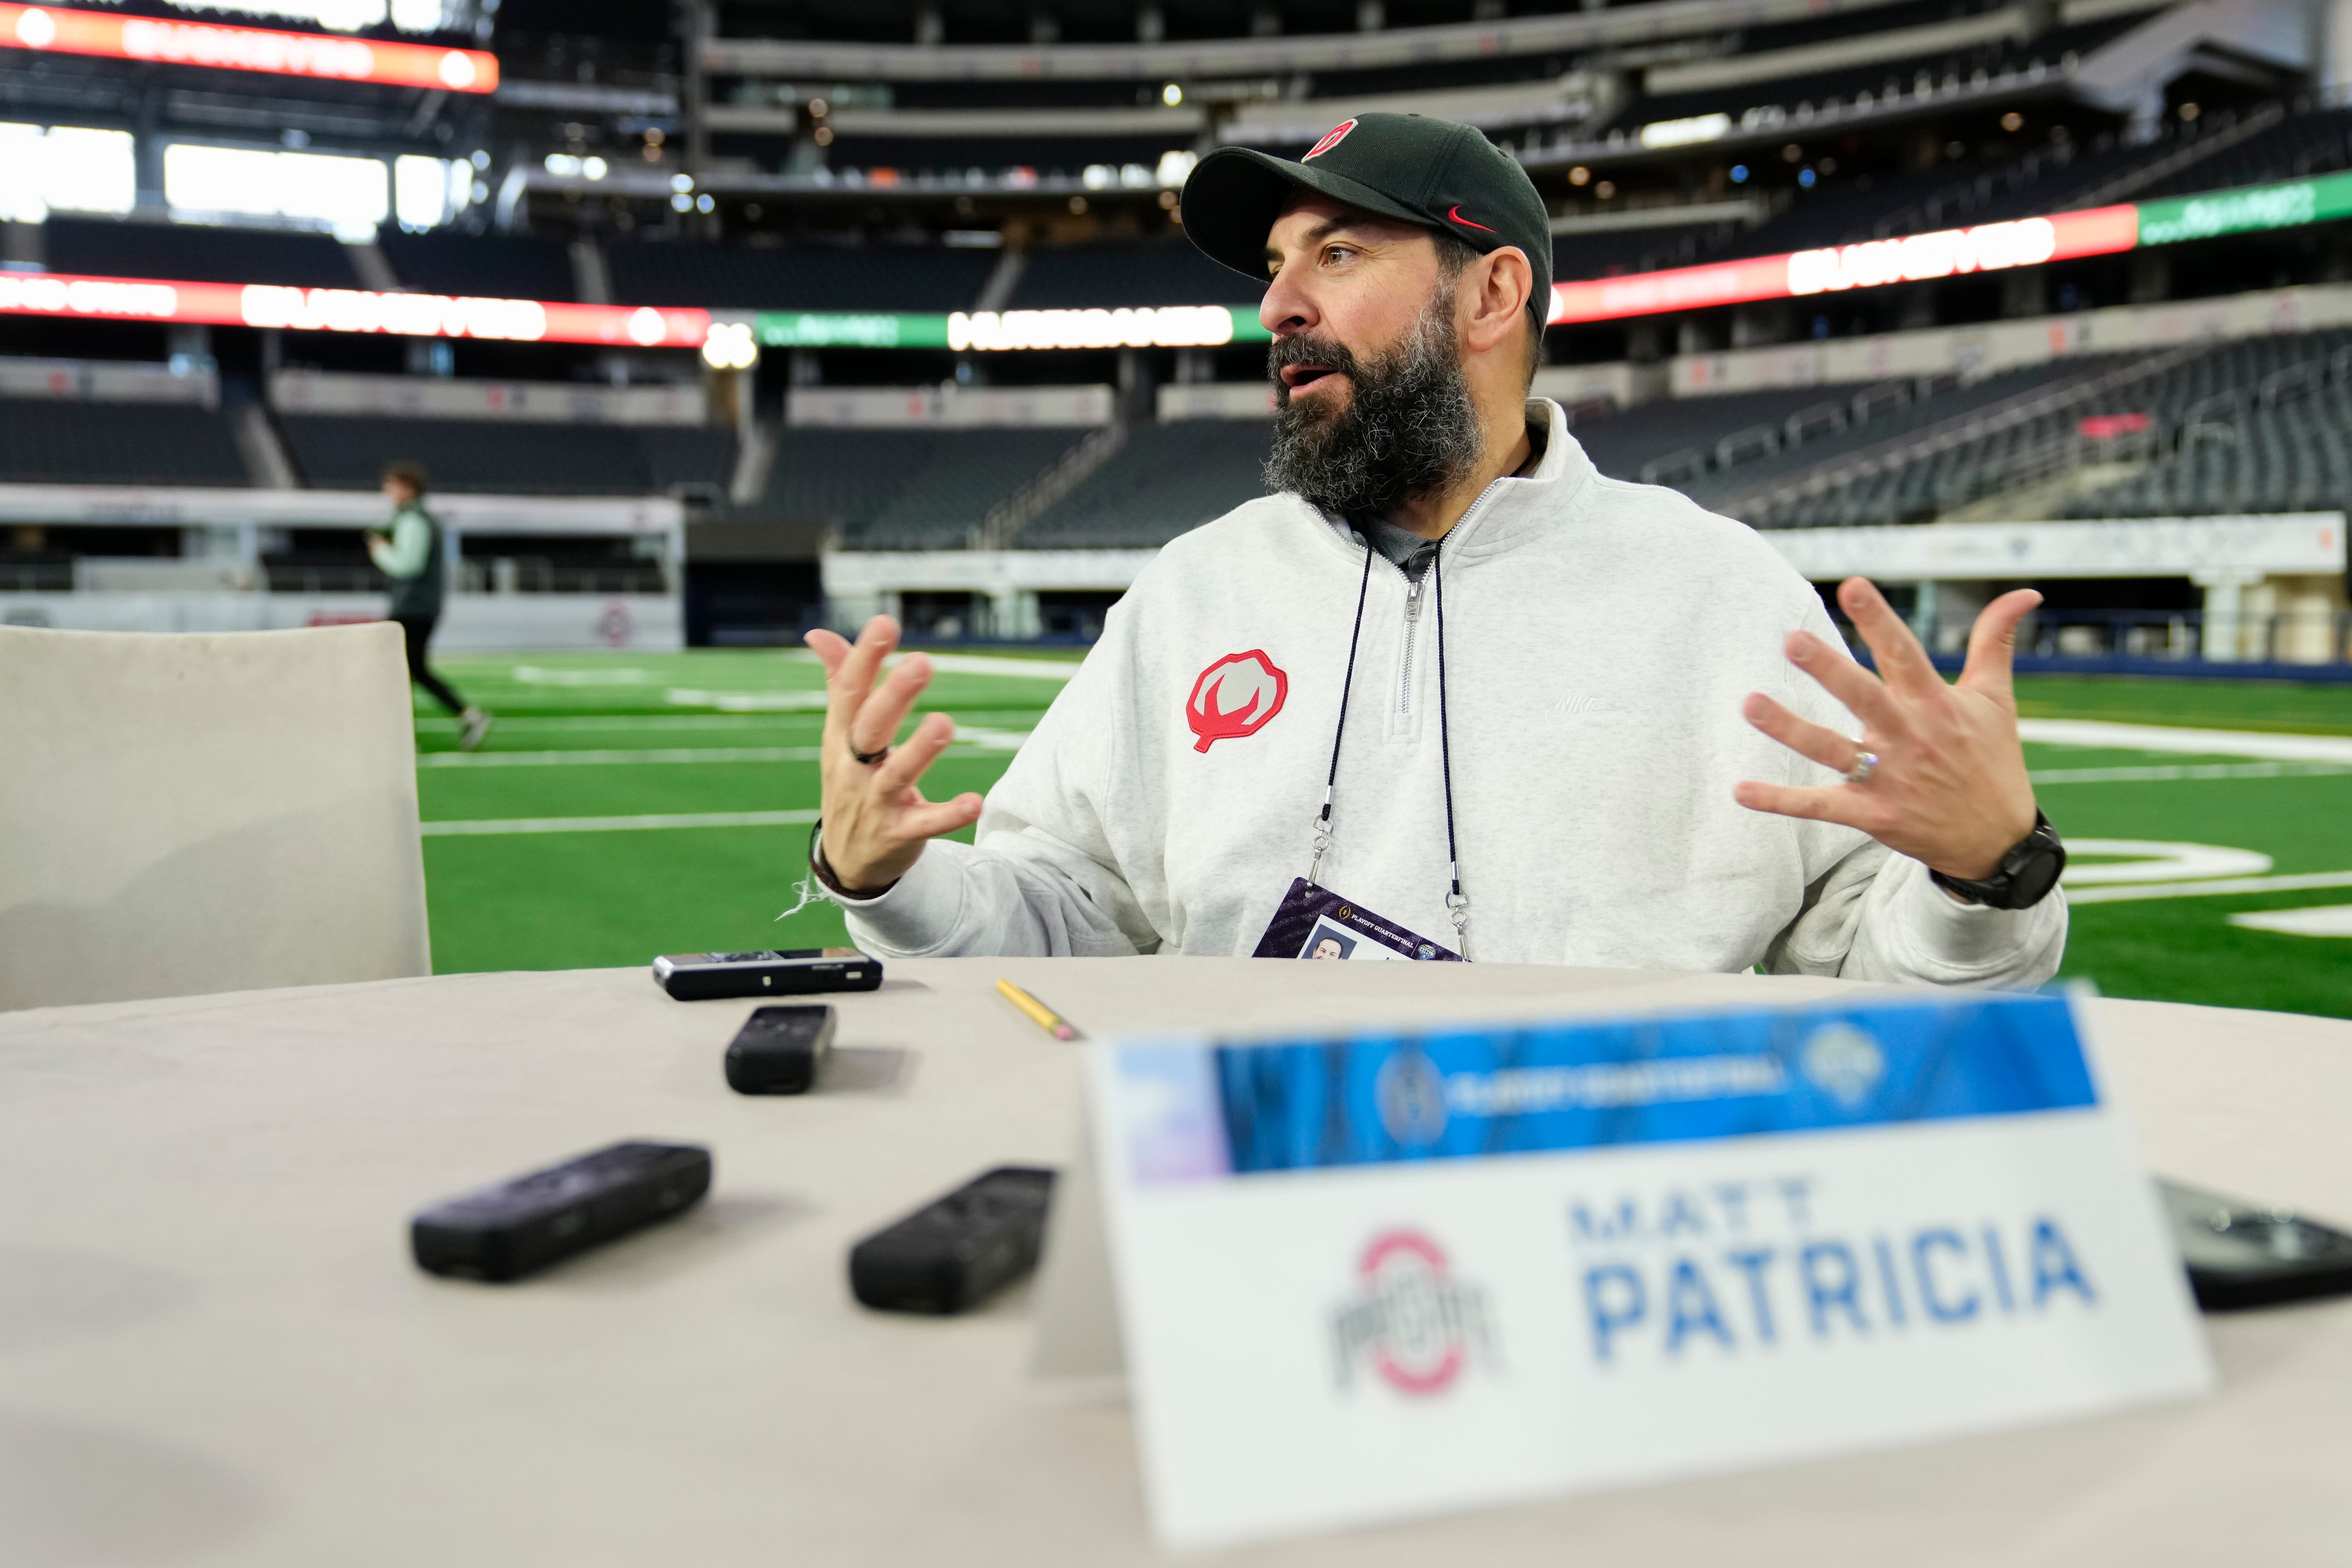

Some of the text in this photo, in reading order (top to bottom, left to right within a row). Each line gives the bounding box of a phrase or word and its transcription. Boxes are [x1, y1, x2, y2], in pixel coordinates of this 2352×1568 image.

[1351, 914, 1375, 928] PLAYOFF
[1374, 925, 1413, 948] QUARTERFINAL
[1567, 1174, 1816, 1244] MATT
[1582, 1214, 2099, 1364] PATRICIA
